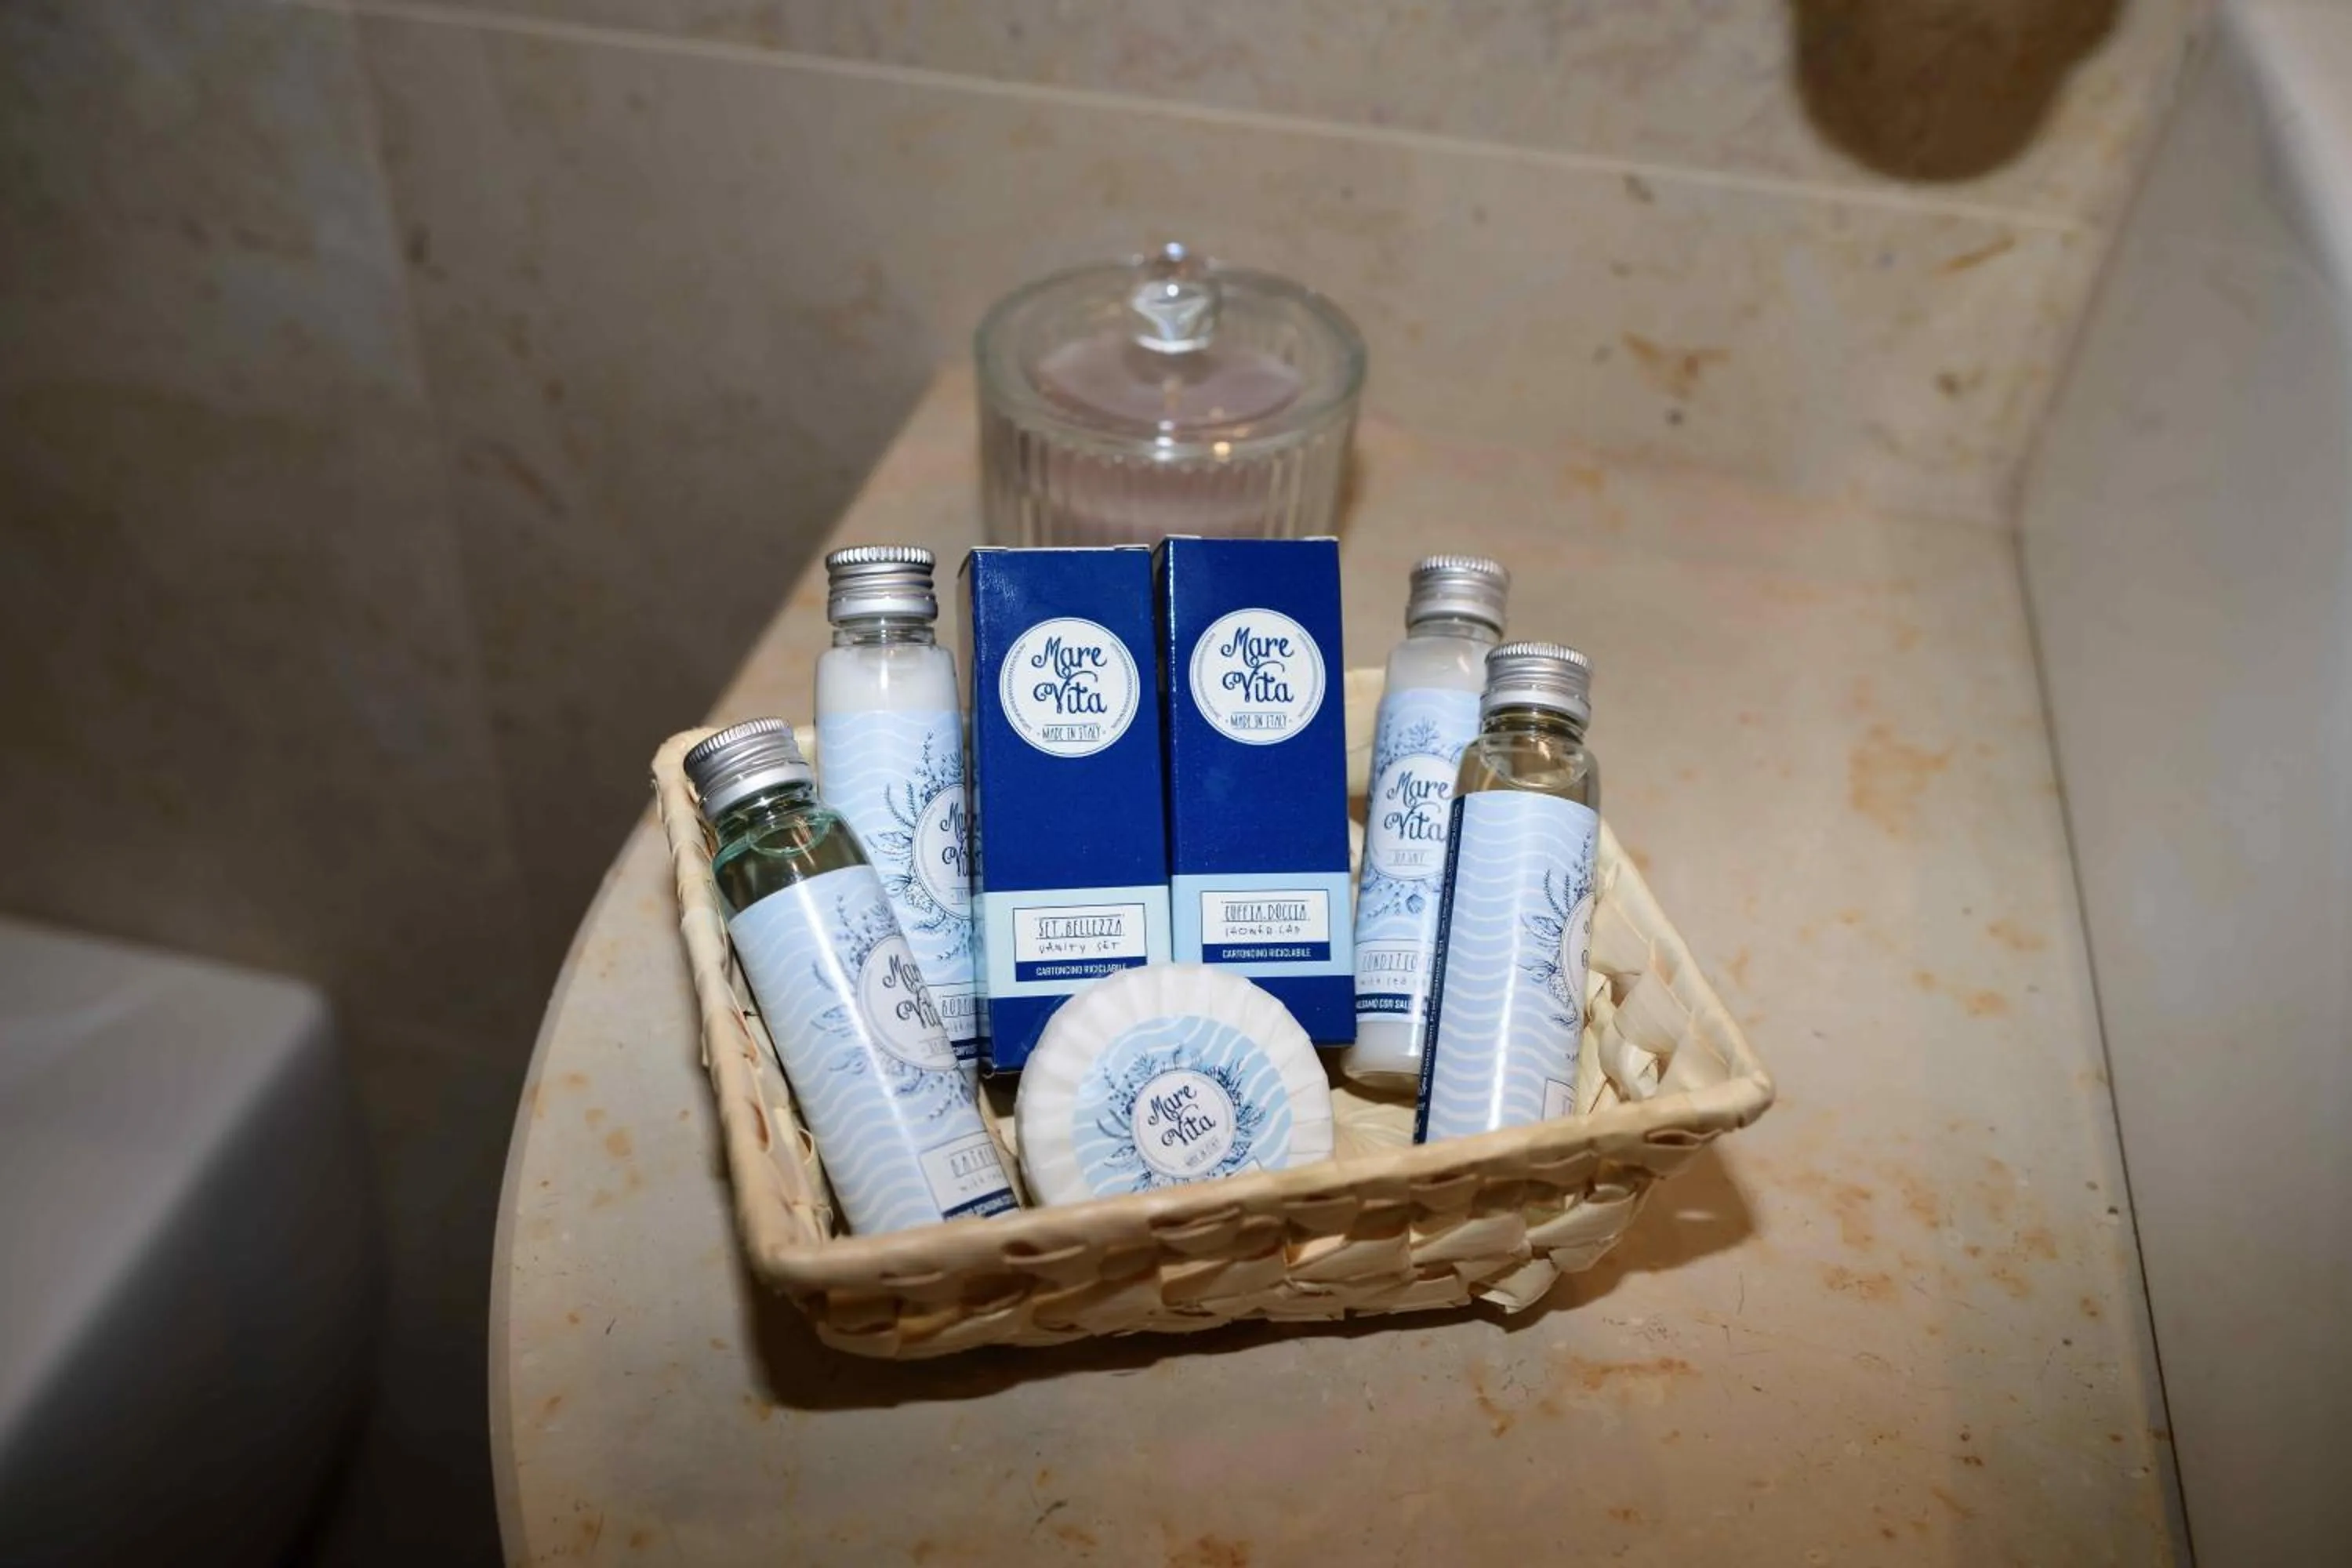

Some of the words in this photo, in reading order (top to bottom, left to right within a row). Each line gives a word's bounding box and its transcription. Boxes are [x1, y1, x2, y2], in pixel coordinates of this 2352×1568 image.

[1031, 636, 1108, 679] Mare
[1221, 626, 1294, 668] Mare
[1033, 670, 1108, 713] Vita
[1222, 661, 1294, 702] Vita
[1386, 771, 1452, 808] Mare
[940, 802, 967, 841] Ma
[1384, 801, 1447, 843] Vita
[942, 836, 971, 877] Vi
[1148, 1085, 1197, 1126] Mare
[1161, 1104, 1216, 1147] Vita
